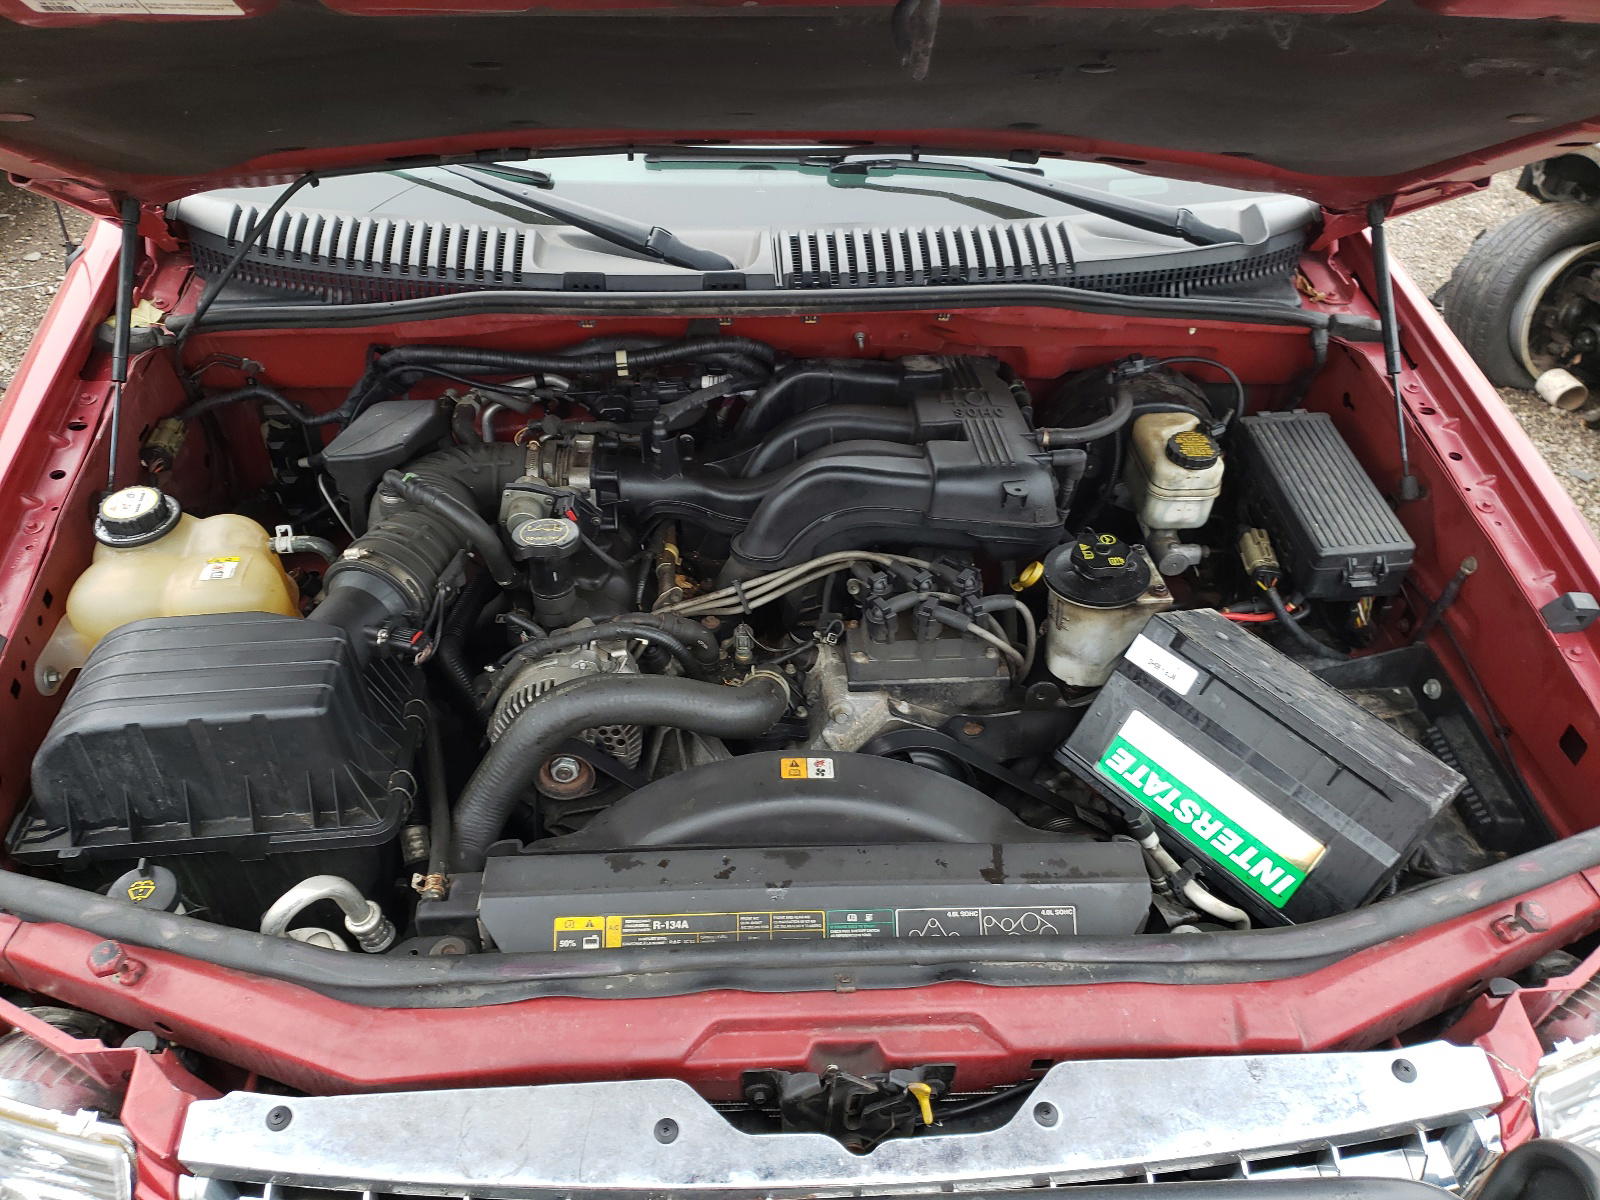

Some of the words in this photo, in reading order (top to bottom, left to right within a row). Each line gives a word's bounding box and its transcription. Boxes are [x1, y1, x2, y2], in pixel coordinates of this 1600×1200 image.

[952, 407, 1007, 418] SOHC
[1105, 747, 1296, 896] INTERSTATE
[652, 919, 690, 930] R-134A
[559, 938, 577, 948] 50%
